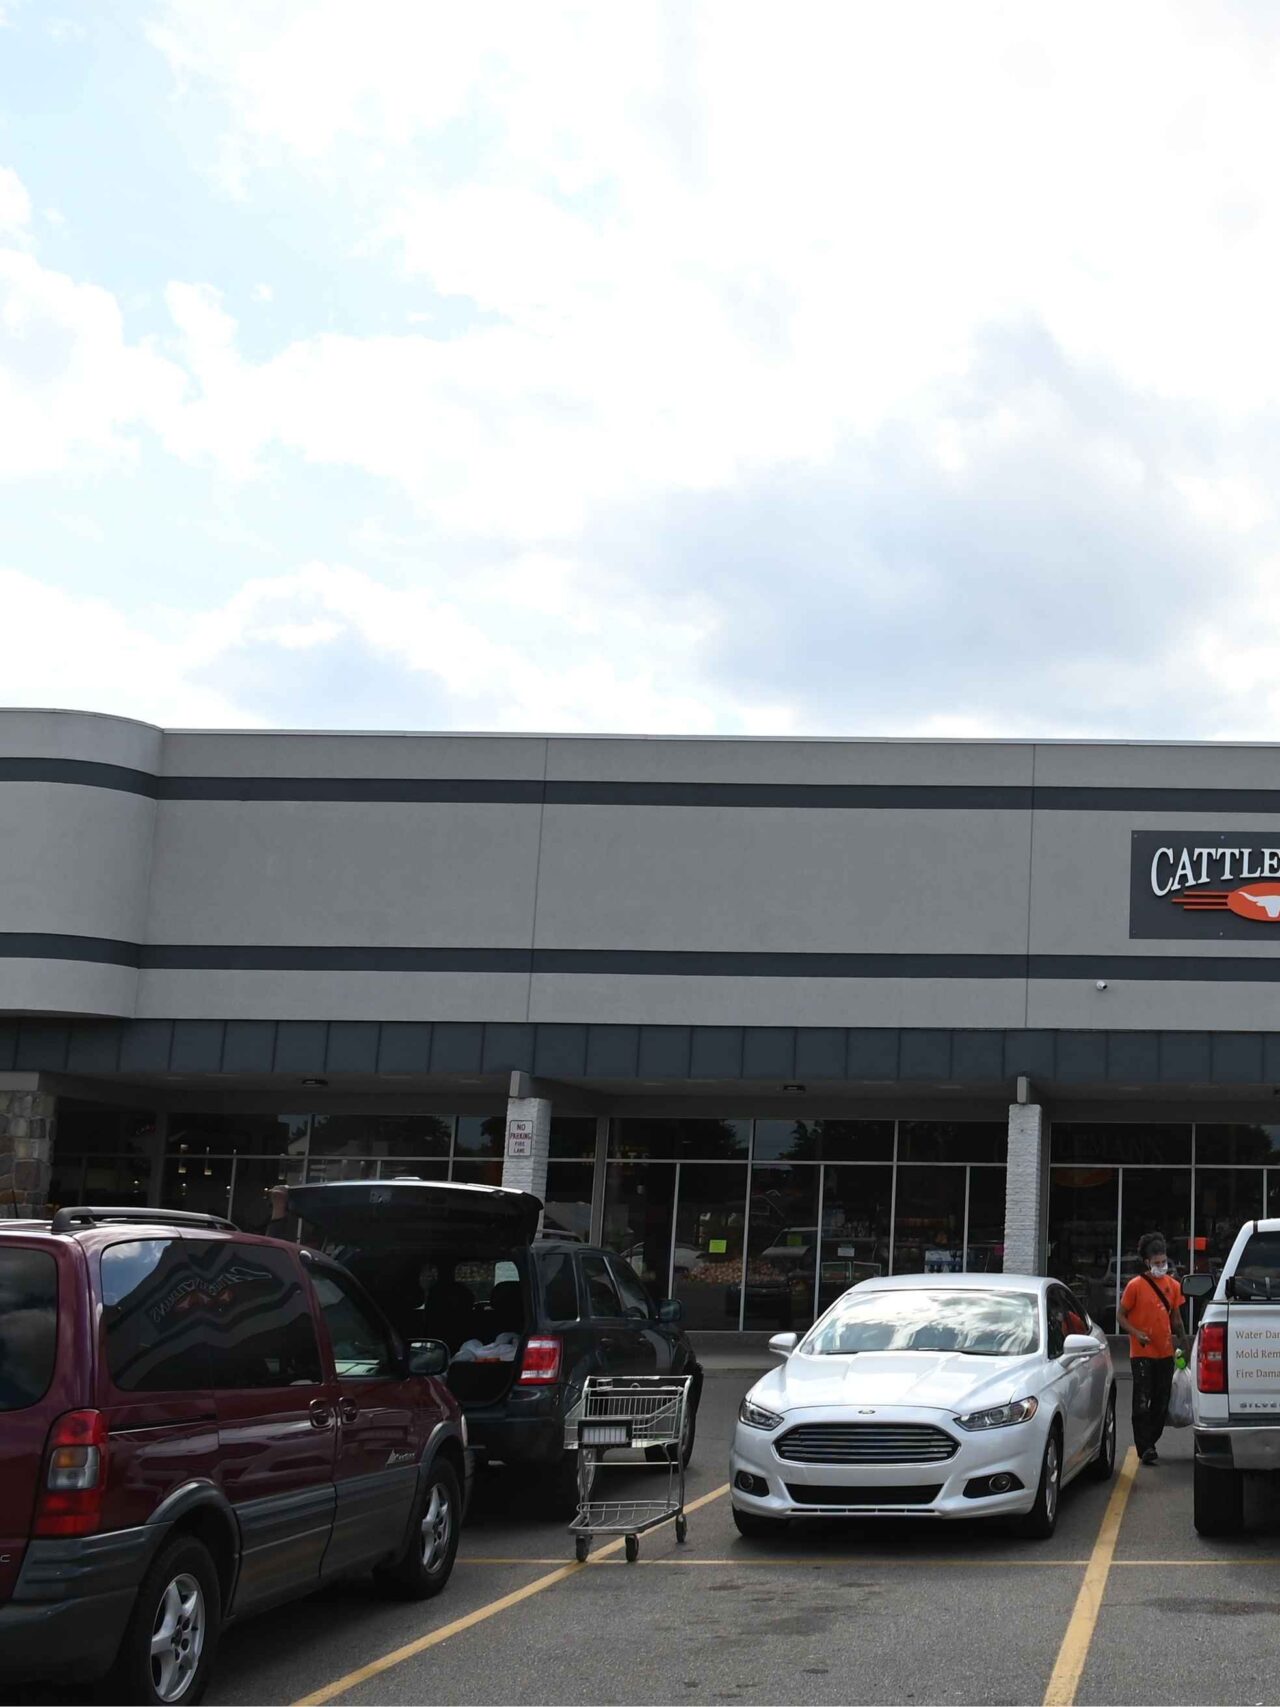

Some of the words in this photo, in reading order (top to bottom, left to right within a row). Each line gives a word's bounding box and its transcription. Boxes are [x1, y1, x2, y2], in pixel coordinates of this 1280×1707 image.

[516, 1123, 526, 1131] NO
[1235, 1330, 1263, 1340] Water
[1235, 1349, 1260, 1360] Mold
[1235, 1369, 1254, 1379] Fire
